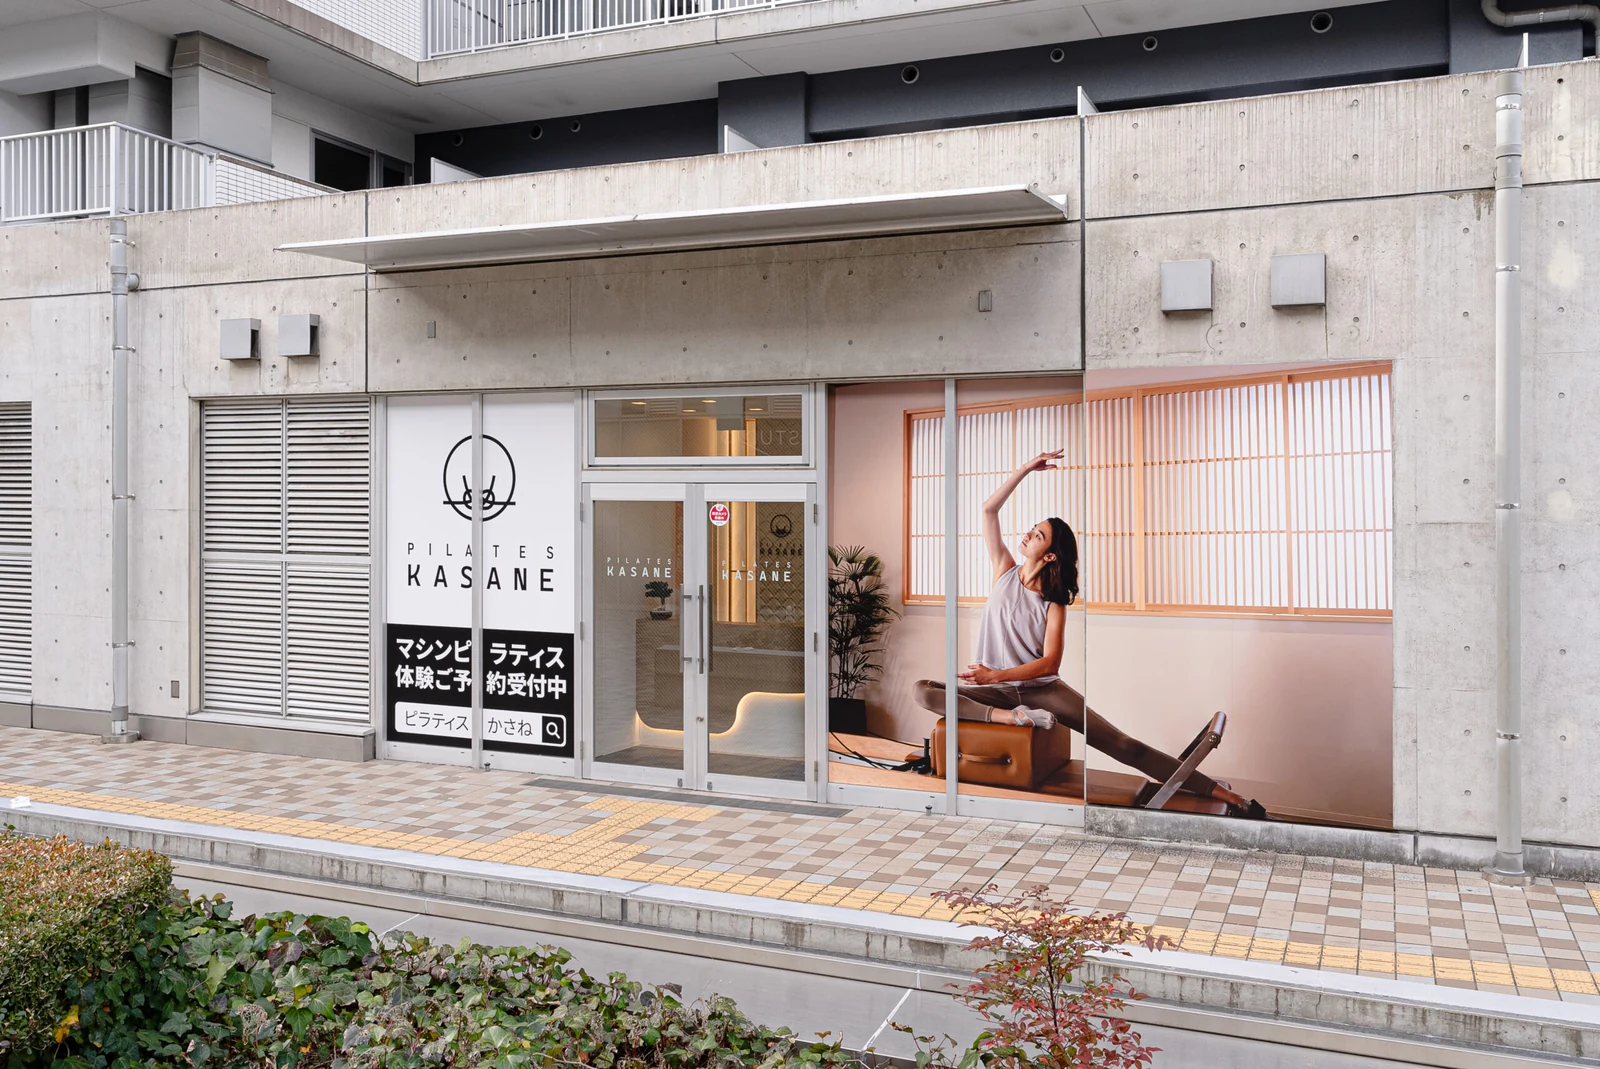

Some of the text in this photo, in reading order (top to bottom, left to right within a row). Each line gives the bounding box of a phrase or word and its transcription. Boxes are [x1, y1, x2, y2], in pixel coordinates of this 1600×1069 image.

[407, 542, 554, 560] PILATES
[606, 556, 672, 565] PILATES
[721, 560, 792, 569] PLATES
[407, 564, 554, 592] KASANE
[607, 566, 672, 578] KASANE
[721, 569, 791, 582] KASANE
[405, 710, 533, 737] ピラティス かさね
